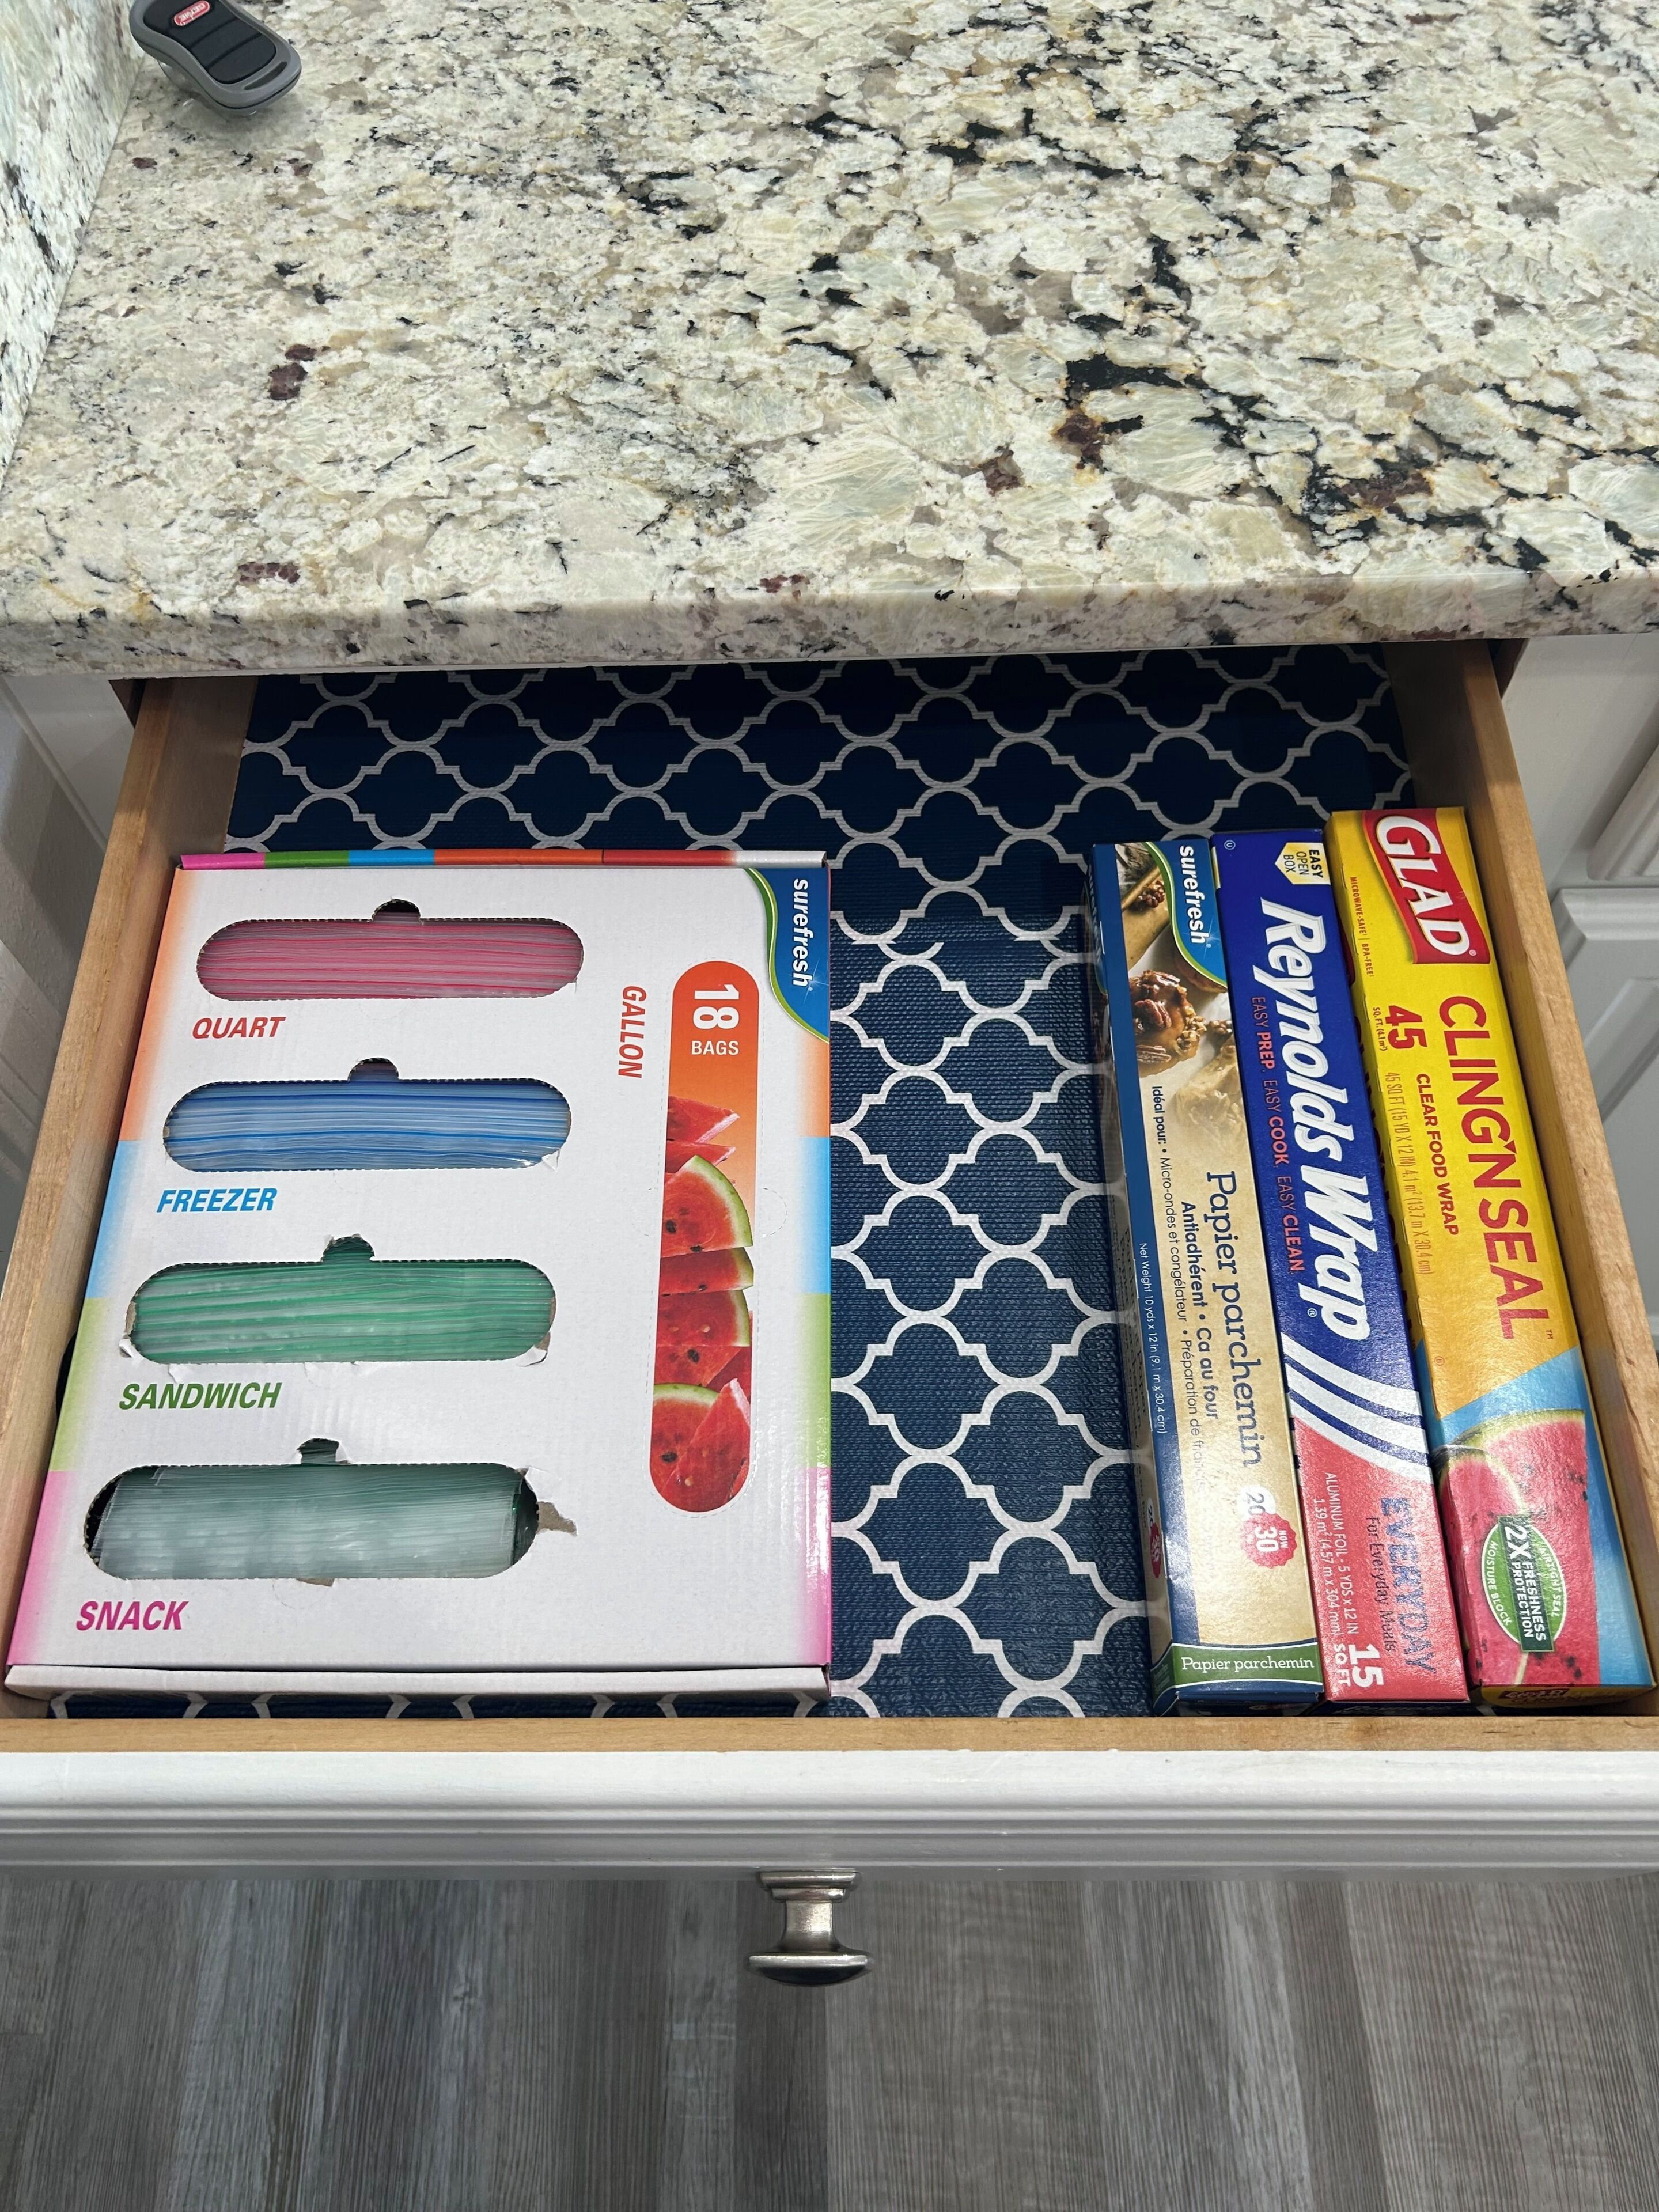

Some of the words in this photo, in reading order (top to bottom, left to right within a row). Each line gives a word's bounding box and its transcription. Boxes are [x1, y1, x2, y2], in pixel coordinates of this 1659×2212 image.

[1283, 854, 1296, 873] BOX
[1296, 851, 1309, 875] OPEN
[1309, 849, 1323, 878] EASY
[1179, 846, 1209, 944] surefresh
[1377, 815, 1470, 955] GLAD
[793, 878, 813, 987] surefresh
[693, 984, 739, 1029] 18
[192, 1017, 286, 1039] QUART
[618, 986, 647, 1078] GALLON
[1252, 897, 1354, 1162] Reynolds
[1385, 1005, 1427, 1049] 45
[691, 1040, 739, 1055] BAGS
[1385, 1072, 1401, 1082] 45
[1152, 1086, 1165, 1113] Idéal
[1387, 1084, 1403, 1094] SQ
[1389, 1096, 1405, 1104] FT
[1416, 1073, 1438, 1126] CLEAR
[1252, 997, 1269, 1028] EASY
[1264, 1080, 1281, 1112] EASY
[1278, 1176, 1296, 1210] EASY
[1388, 1108, 1408, 1120] (15
[1393, 1122, 1410, 1134] YD
[1397, 1145, 1414, 1154] 12
[1398, 1156, 1416, 1166] IN)
[1427, 1131, 1448, 1178] FOOD
[1402, 1169, 1419, 1181] 4.1
[156, 1188, 277, 1212] FREEZER
[1160, 1157, 1177, 1228] Micro-ondes
[1403, 1198, 1426, 1218] (13.7
[1437, 1182, 1459, 1235] WRAP
[1203, 1171, 1238, 1274] Papier
[1169, 1232, 1180, 1243] et
[1414, 1239, 1433, 1258] 30.4
[1139, 1243, 1149, 1258] Net
[1181, 1201, 1208, 1307] Antiadhérent
[1141, 1261, 1152, 1291] Weight
[1416, 1260, 1436, 1275] cm)
[1171, 1247, 1187, 1322] congélateur
[1145, 1296, 1154, 1305] 10
[1144, 1307, 1156, 1322] yds
[1149, 1332, 1158, 1342] 12
[1150, 1344, 1159, 1353] in
[1149, 1355, 1161, 1370] (9.1
[1200, 1358, 1213, 1380] au
[1153, 1374, 1160, 1383] m
[1212, 1282, 1265, 1467] parchemin
[119, 1382, 282, 1410] SANDWICH
[1180, 1340, 1198, 1414] Préparation
[1190, 1419, 1202, 1435] de
[1155, 1393, 1165, 1413] 30.4
[1203, 1384, 1218, 1419] four
[1157, 1415, 1168, 1434] cm)
[1246, 1492, 1266, 1515] 20
[1313, 1498, 1328, 1519] 1.39
[1325, 1472, 1345, 1531] ALUMINUM
[1255, 1526, 1279, 1552] 30
[1278, 1530, 1289, 1549] NOW
[1366, 1517, 1379, 1540] For
[1334, 1533, 1348, 1557] FOIL
[1505, 1525, 1532, 1562] 2X
[1323, 1567, 1332, 1577] m
[1369, 1543, 1389, 1609] Everyday
[1484, 1540, 1498, 1592] MOISTURE
[1340, 1575, 1353, 1596] YDS
[1381, 1498, 1436, 1673] EVERYDAY
[1325, 1588, 1339, 1608] 304
[1490, 1593, 1512, 1626] BLOCK
[1511, 1562, 1533, 1638] PROTECTION
[1522, 1561, 1547, 1642] FRESHNESS
[1551, 1594, 1562, 1617] SEAL
[75, 1601, 188, 1630] SNACK
[1344, 1608, 1358, 1620] 12
[1346, 1623, 1359, 1634] IN
[1380, 1611, 1397, 1652] Meals
[1181, 1657, 1230, 1673] Papier
[1233, 1656, 1315, 1672] parchemin
[1334, 1643, 1347, 1665] SQ
[1348, 1643, 1385, 1688] 15
[1337, 1669, 1351, 1687] FT
